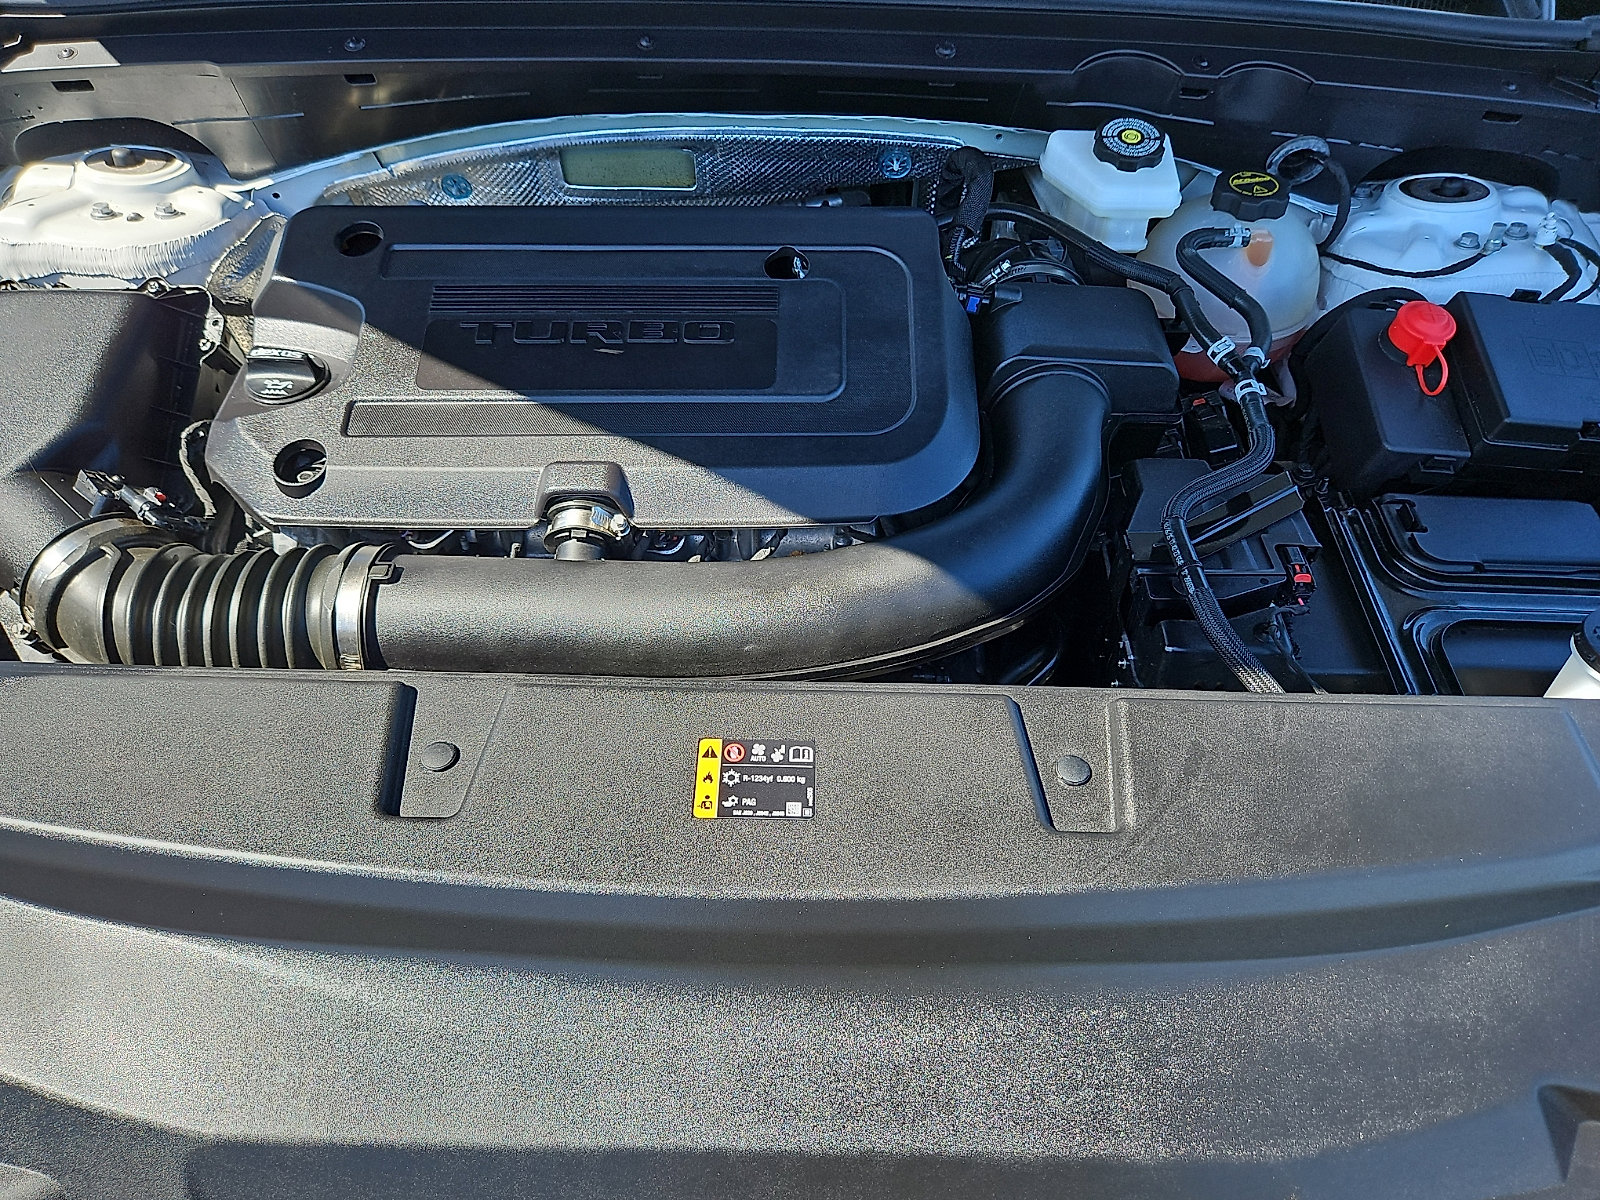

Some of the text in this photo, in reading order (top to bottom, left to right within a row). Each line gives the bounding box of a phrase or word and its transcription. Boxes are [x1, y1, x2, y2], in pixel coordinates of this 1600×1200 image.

[459, 319, 736, 345] TURBO
[743, 775, 773, 783] R-1234yf
[797, 776, 805, 784] kg
[741, 798, 757, 806] PAG
